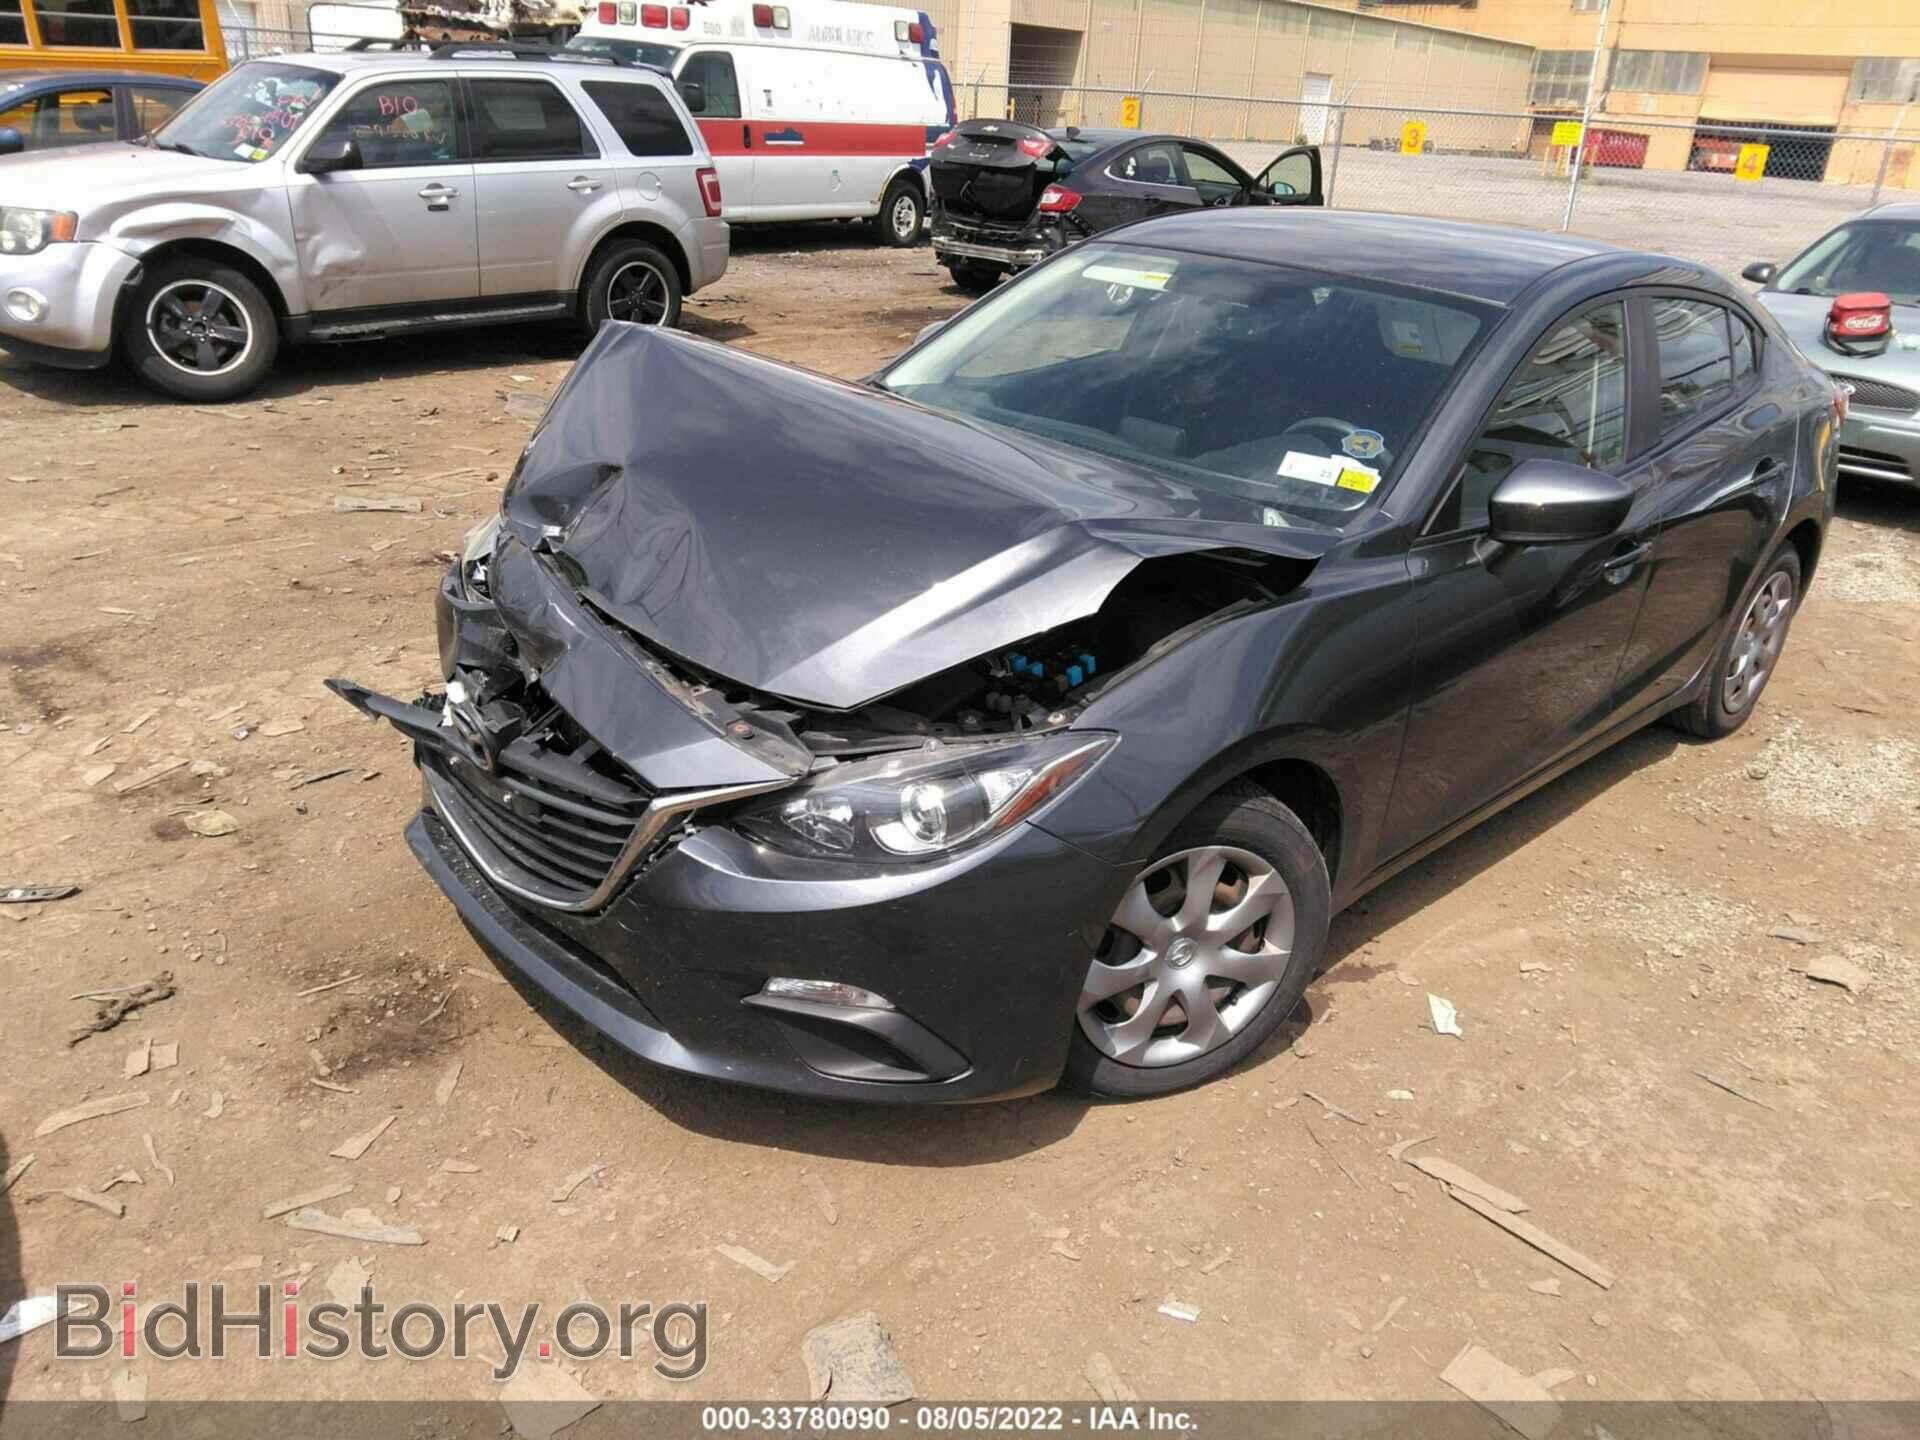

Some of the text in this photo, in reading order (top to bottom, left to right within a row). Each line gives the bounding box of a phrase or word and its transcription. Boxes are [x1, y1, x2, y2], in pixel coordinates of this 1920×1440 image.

[1126, 103, 1136, 121] 2
[1407, 128, 1420, 148] 3
[1742, 152, 1758, 173] 4
